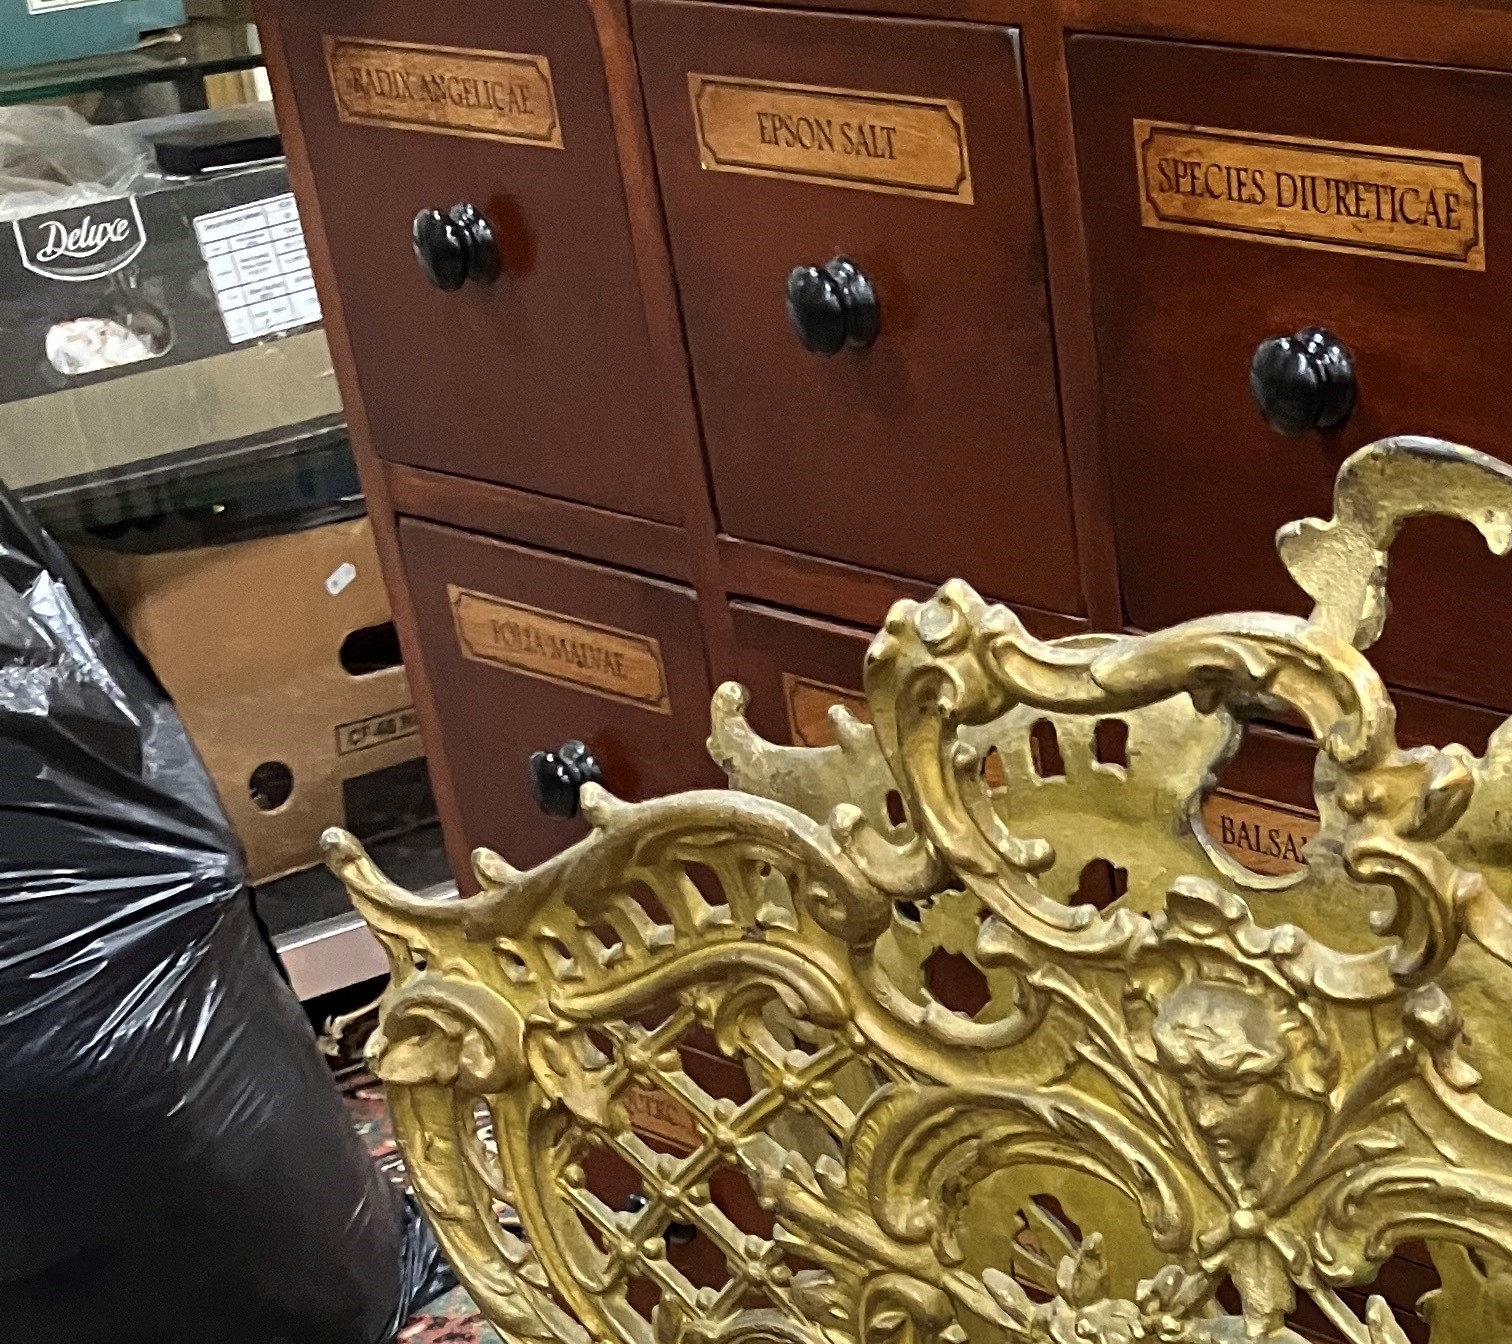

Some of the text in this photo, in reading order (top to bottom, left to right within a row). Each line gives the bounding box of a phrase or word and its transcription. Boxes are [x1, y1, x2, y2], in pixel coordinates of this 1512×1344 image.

[350, 66, 534, 115] RADIX ANGELICAE
[756, 111, 897, 160] EPSON SALT
[1157, 157, 1462, 231] SPECIES DIURETICAE
[36, 215, 130, 262] Deluxe
[1220, 814, 1310, 866] BALSA
